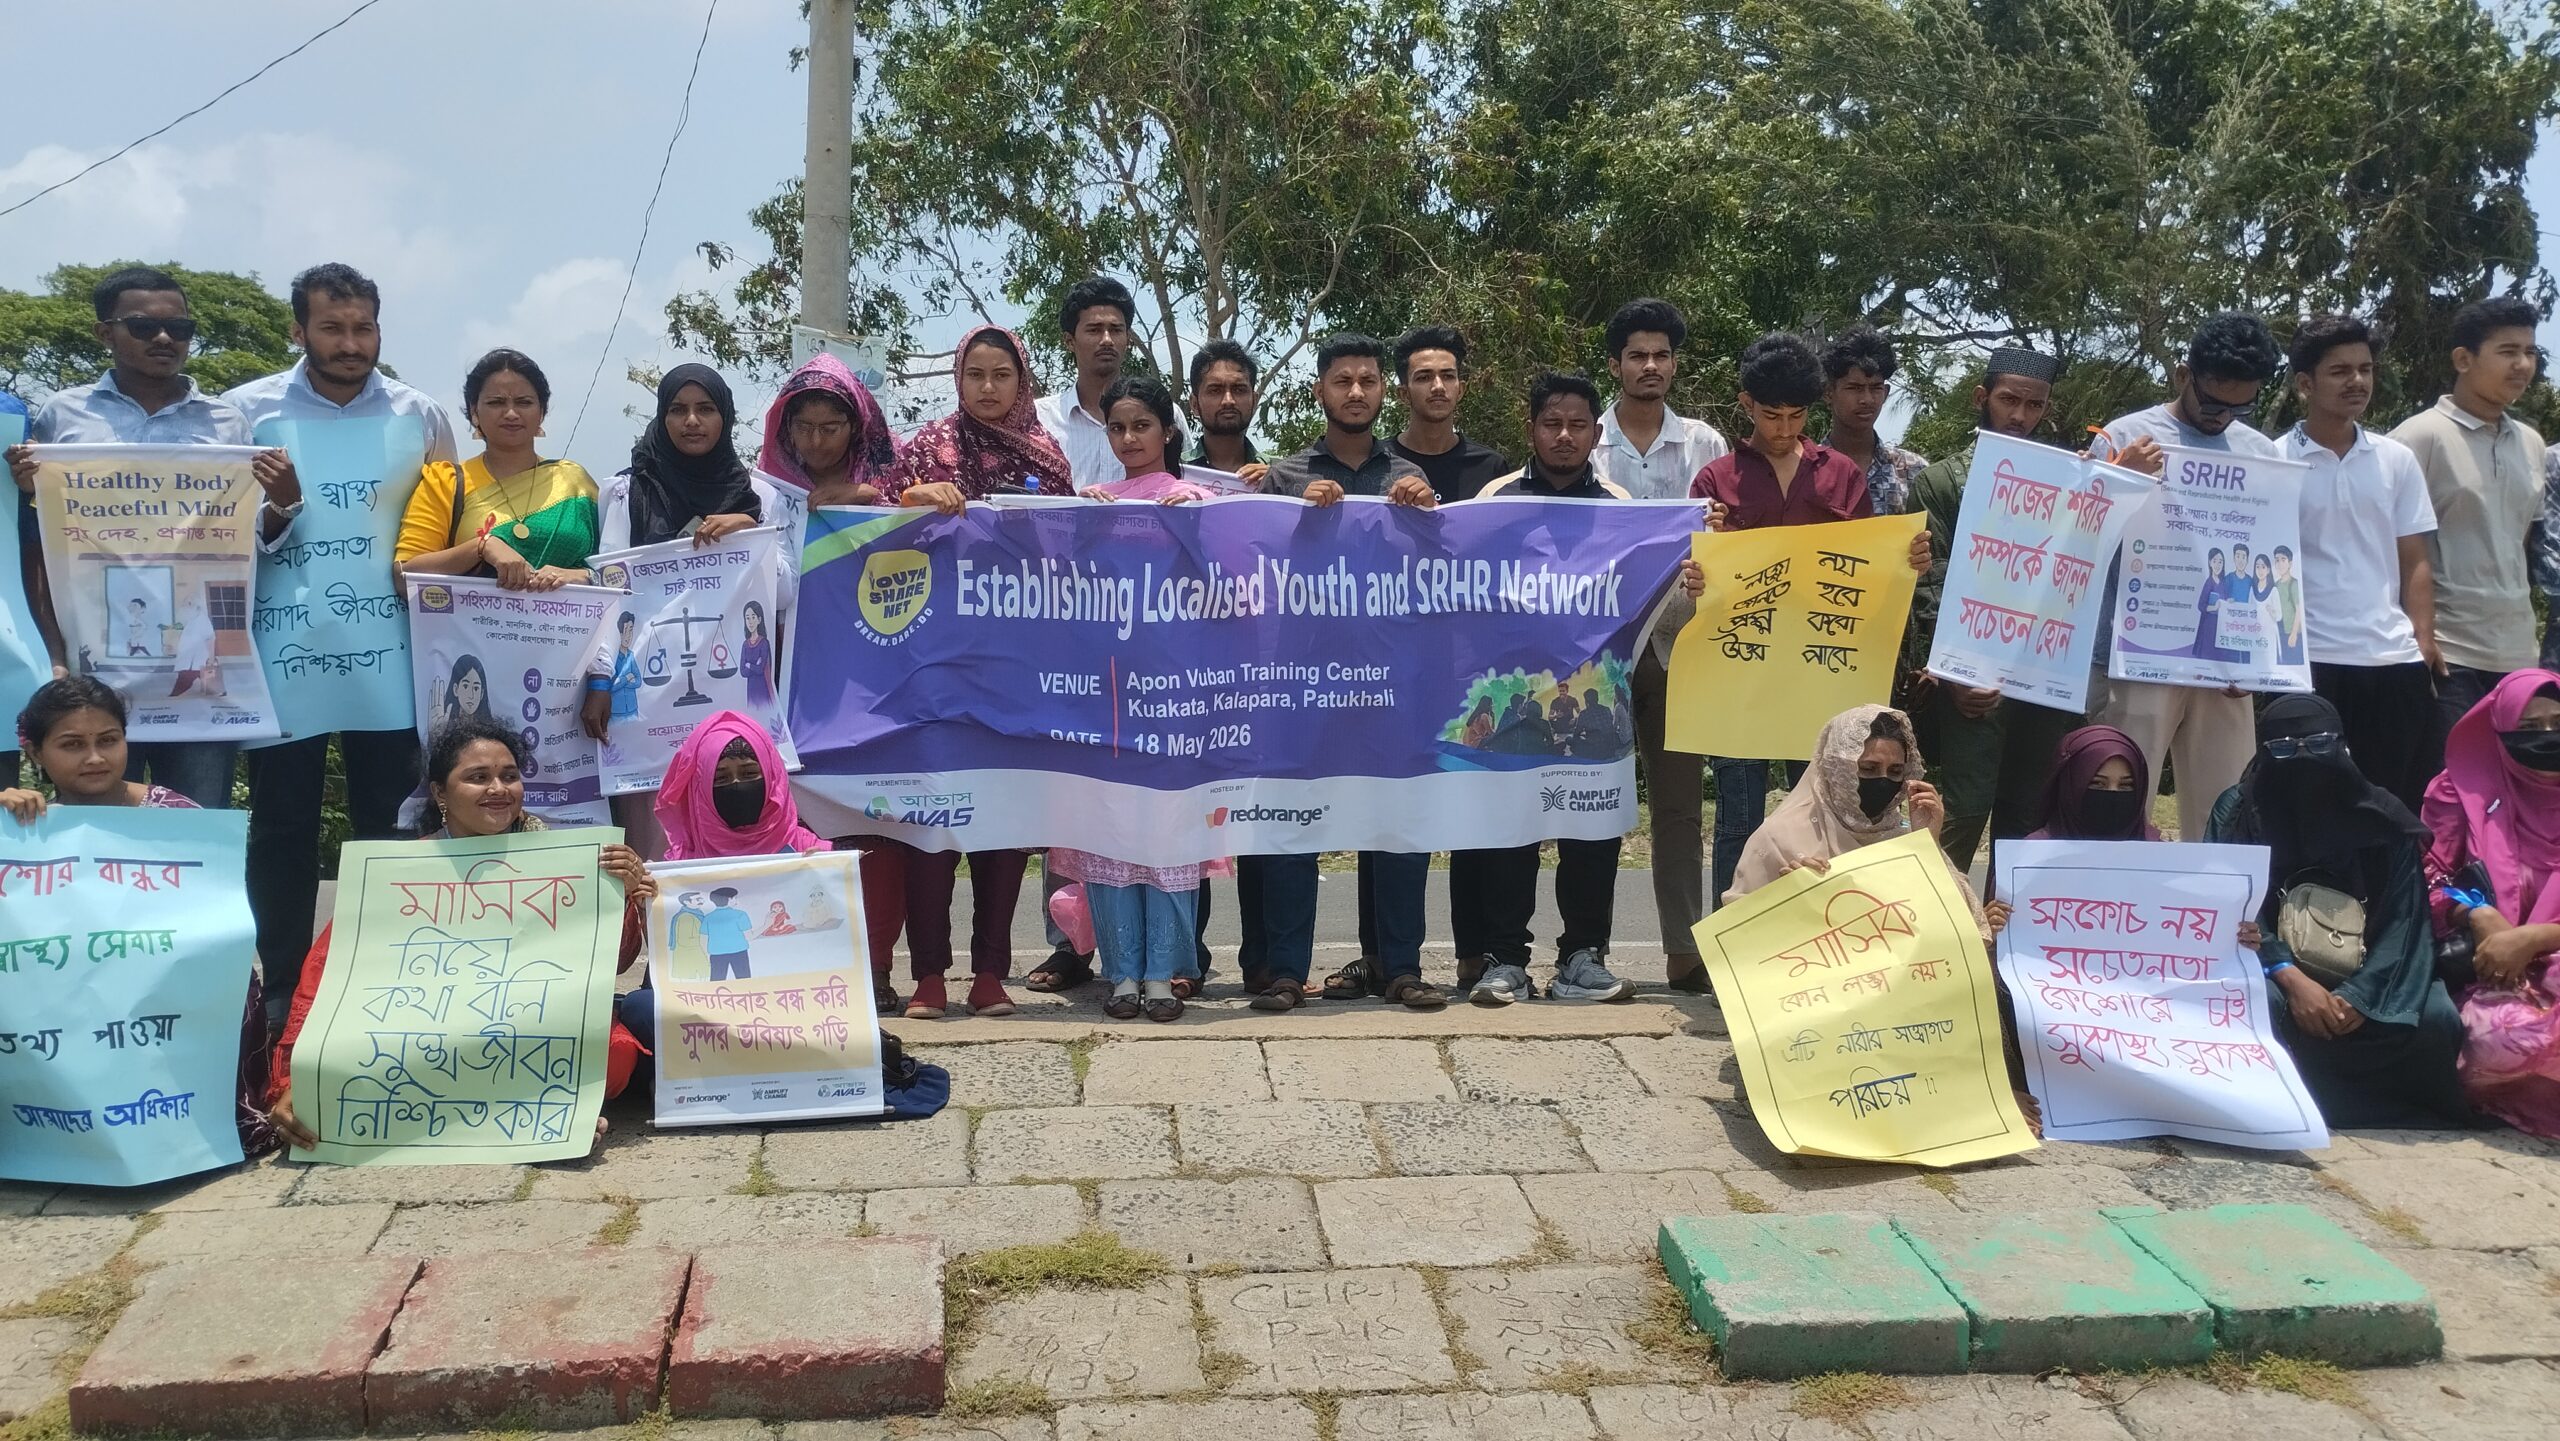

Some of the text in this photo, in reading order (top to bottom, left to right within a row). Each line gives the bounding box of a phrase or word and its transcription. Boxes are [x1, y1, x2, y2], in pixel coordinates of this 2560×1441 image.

[64, 471, 235, 494] Healthy Body
[2180, 460, 2246, 491] SRHR
[64, 499, 237, 518] Peaceful Mind
[1988, 458, 2114, 536] নিজের শরীর
[211, 527, 238, 541] মন
[274, 536, 377, 569] সচেতনতা
[632, 550, 750, 577] জেন্ডার সমতা নয়
[1817, 551, 1869, 577] নয়
[869, 566, 927, 590] YOUTH
[1969, 533, 2095, 609] সম্পর্কে জানুন
[869, 582, 925, 605] SHARE
[883, 600, 912, 619] NET
[957, 554, 1623, 641] Establishing Localised Youth and SRHR Network
[1816, 581, 1866, 607] হবে
[585, 602, 604, 620] চাই
[1807, 611, 1864, 636] করো
[1960, 597, 2075, 663] সচেতন হোন
[1039, 672, 1102, 696] VENUE
[1126, 662, 1390, 696] Apon Vuban Training Center
[1128, 688, 1395, 719] Kuakata, Kalapara, Patukhali
[225, 716, 261, 725] AVAS
[1050, 728, 1102, 746] DATE
[1134, 723, 1252, 760] 18 May 2026
[1210, 785, 1234, 794] HOSTED
[1541, 770, 1588, 778] SUPPORTED
[898, 792, 973, 807] আভাস
[1569, 786, 1621, 801] AMPLIFY
[1569, 799, 1620, 812] CHANGE
[899, 807, 975, 828] AVAS
[94, 857, 203, 893] বান্ধব
[390, 859, 585, 932] মাসিক
[1758, 889, 1917, 978] মাসিক
[2029, 897, 2219, 943] সংকোচ নয়
[88, 929, 177, 964] সেবার
[389, 926, 513, 980] নিয়ে
[2039, 946, 2220, 985] সচেতনতা
[362, 960, 574, 1024] কথা বলি
[673, 975, 848, 1014] বাল্যবিবাহ বন্ধ করি
[1778, 986, 1830, 1012] কোন
[2203, 980, 2253, 1030] চাই
[93, 1014, 181, 1051] পাওয়া
[680, 1015, 849, 1062] সুন্দর ভবিষ্যৎ গড়ি
[1836, 1022, 1888, 1055] নারীর
[460, 1023, 577, 1085] জীবন
[832, 1087, 866, 1098] AVAS
[1829, 1065, 1917, 1120] পরিচয়
[12, 1088, 195, 1135] আমাদের অধিকার
[495, 1084, 578, 1141] করি
